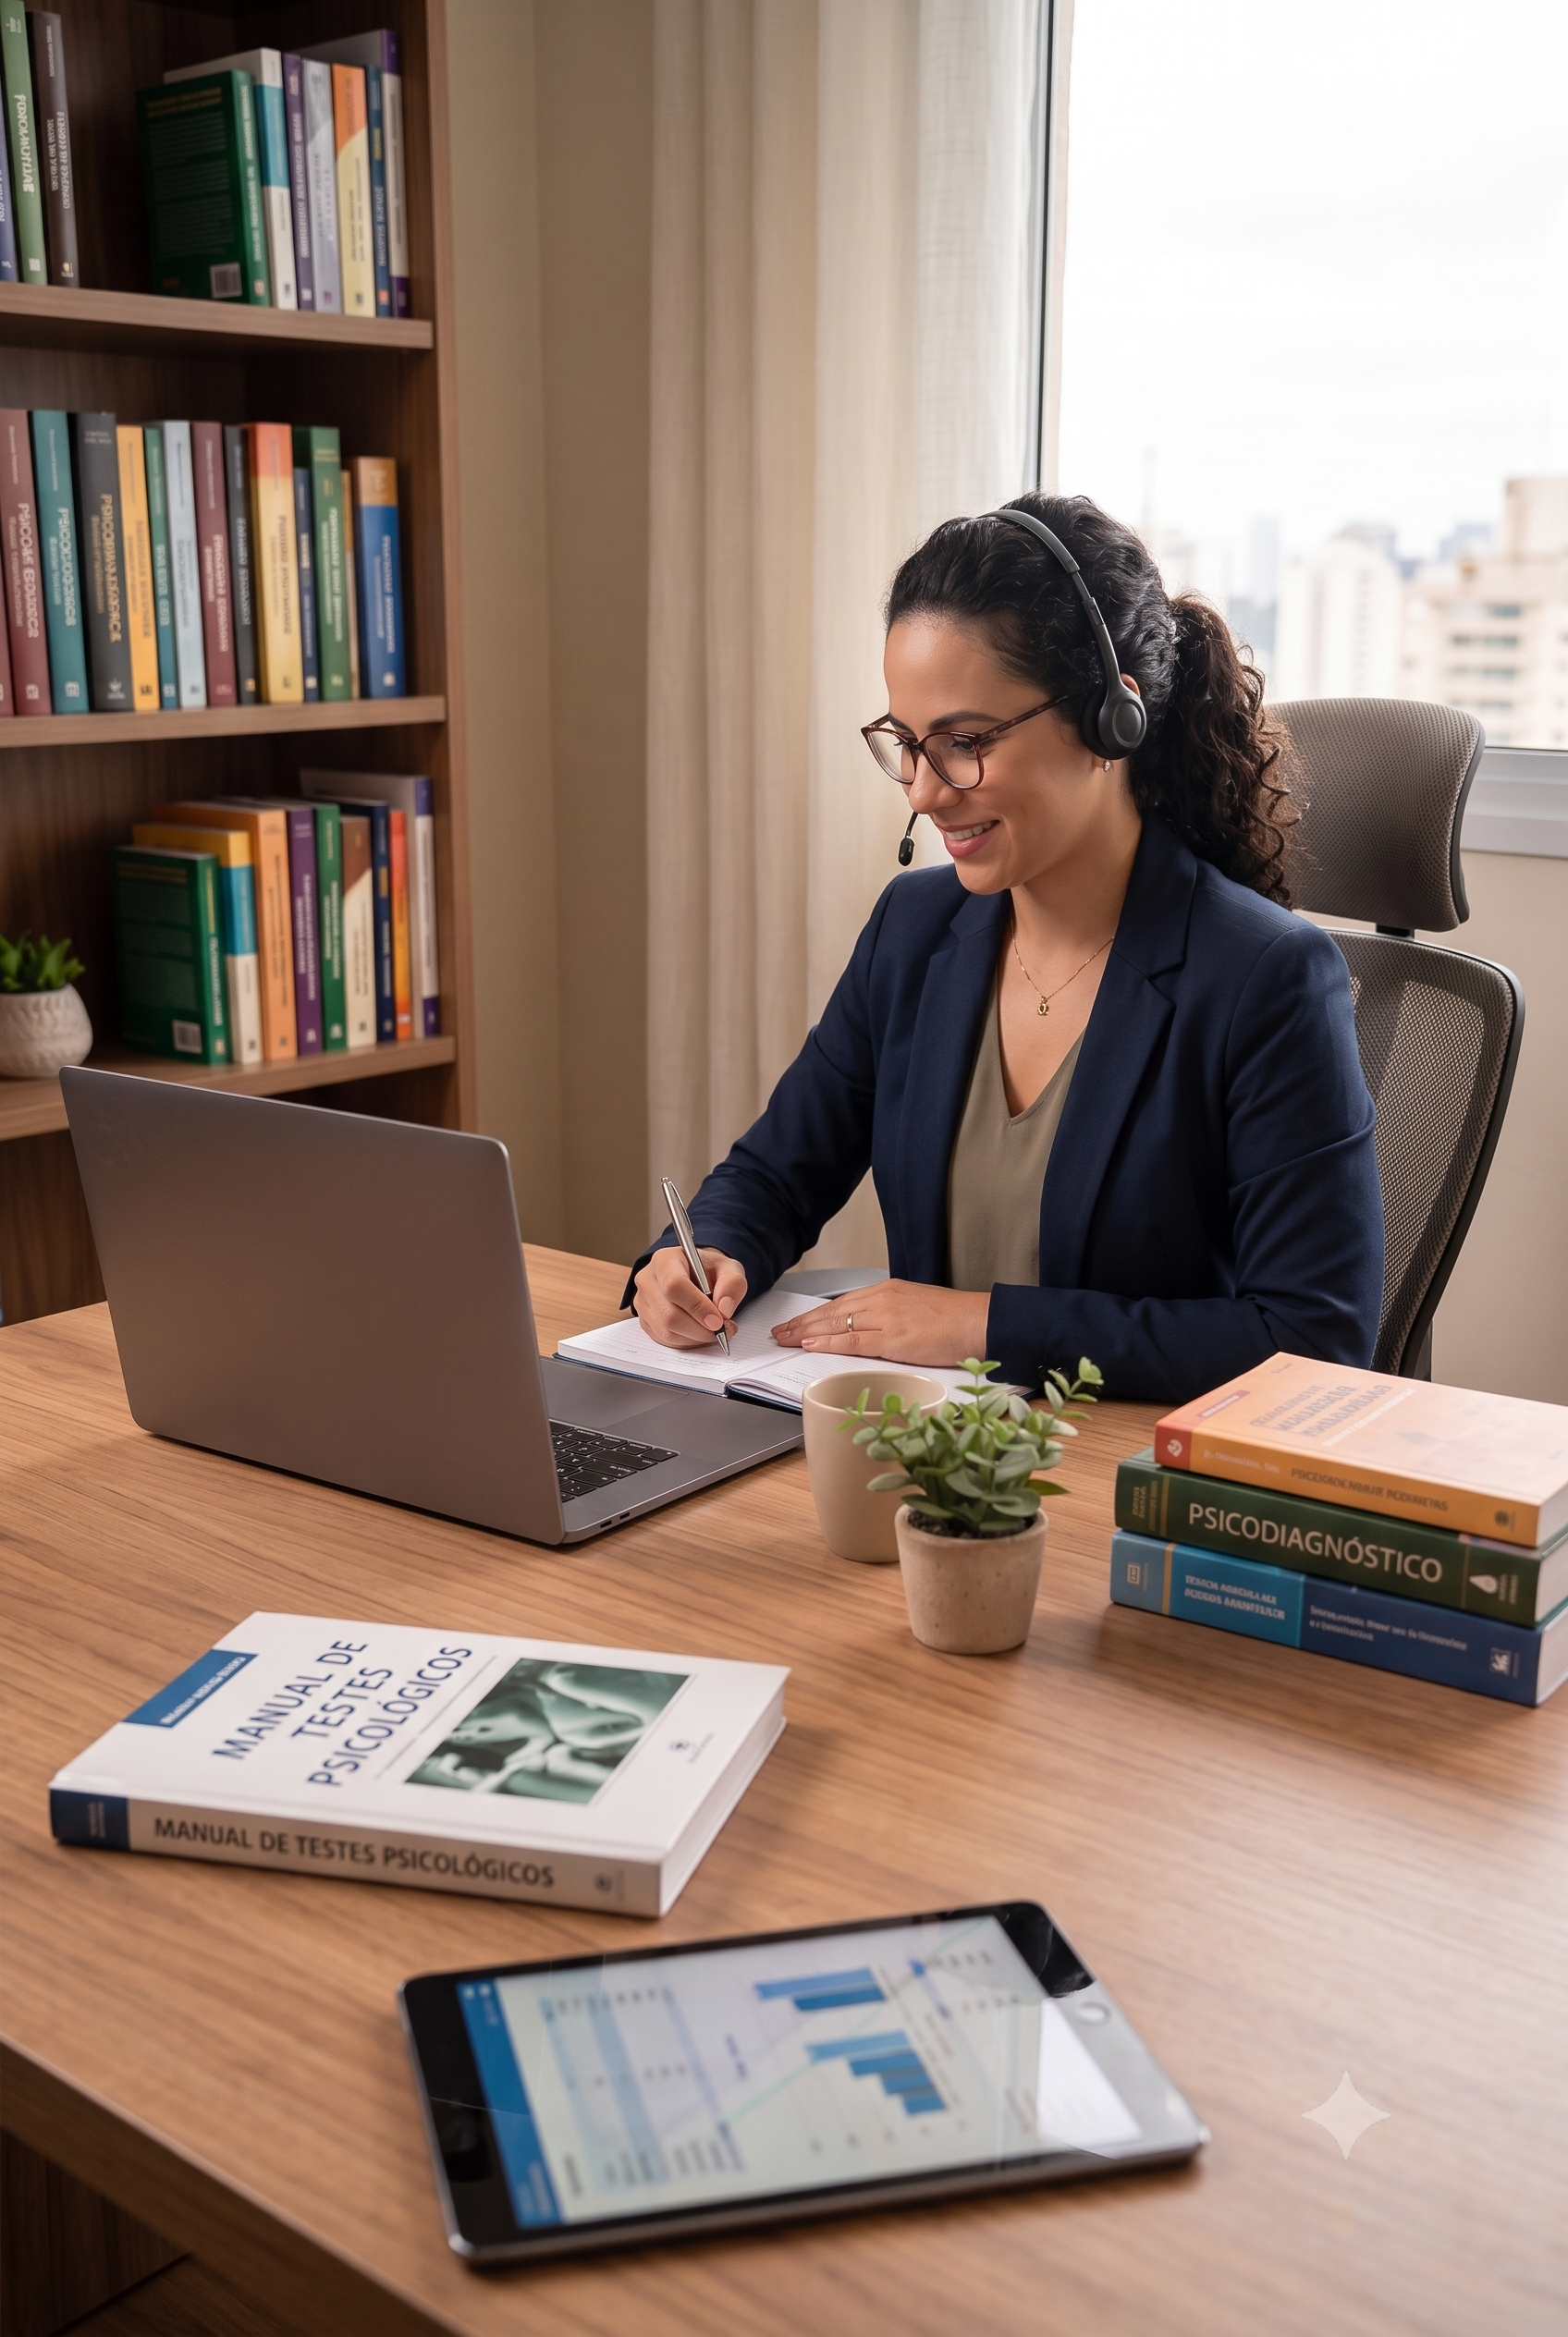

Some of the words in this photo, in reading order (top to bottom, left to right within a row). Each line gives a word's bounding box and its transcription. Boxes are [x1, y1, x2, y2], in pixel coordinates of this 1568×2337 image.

[1188, 1502, 1443, 1584] PSICODIAGNÓSTICO
[212, 1671, 333, 1760] MANUAL
[316, 1640, 368, 1666] DE
[290, 1667, 393, 1740] TESTES
[306, 1646, 473, 1786] PSICOLÓGICOS
[153, 1816, 255, 1851] MANUAL
[259, 1829, 288, 1854] DE
[294, 1834, 376, 1866] TESTES
[383, 1843, 555, 1890] PSICOLÓGICOS
